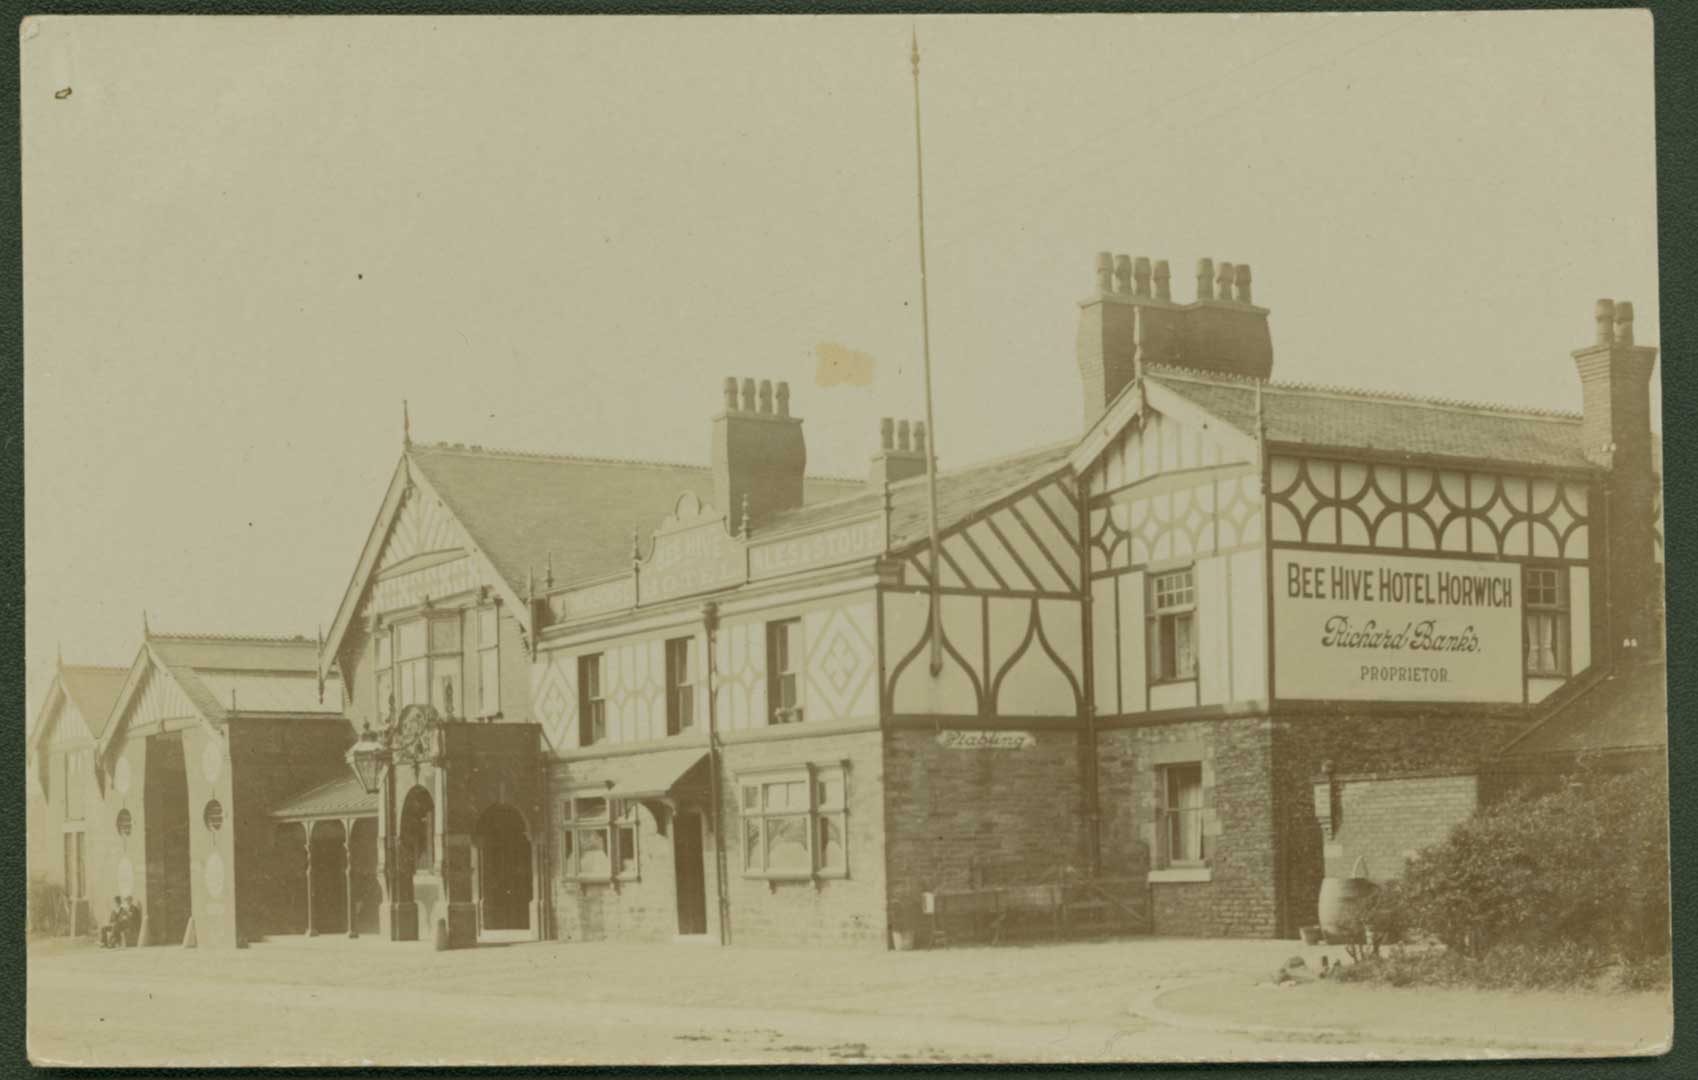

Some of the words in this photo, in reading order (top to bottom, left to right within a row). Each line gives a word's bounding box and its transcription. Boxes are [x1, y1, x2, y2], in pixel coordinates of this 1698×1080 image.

[1288, 562, 1325, 599] BEE
[1331, 565, 1375, 602] HIVE
[1379, 567, 1436, 606] HOTEL
[1437, 570, 1513, 609] HORWICH
[1320, 615, 1412, 652] Richard
